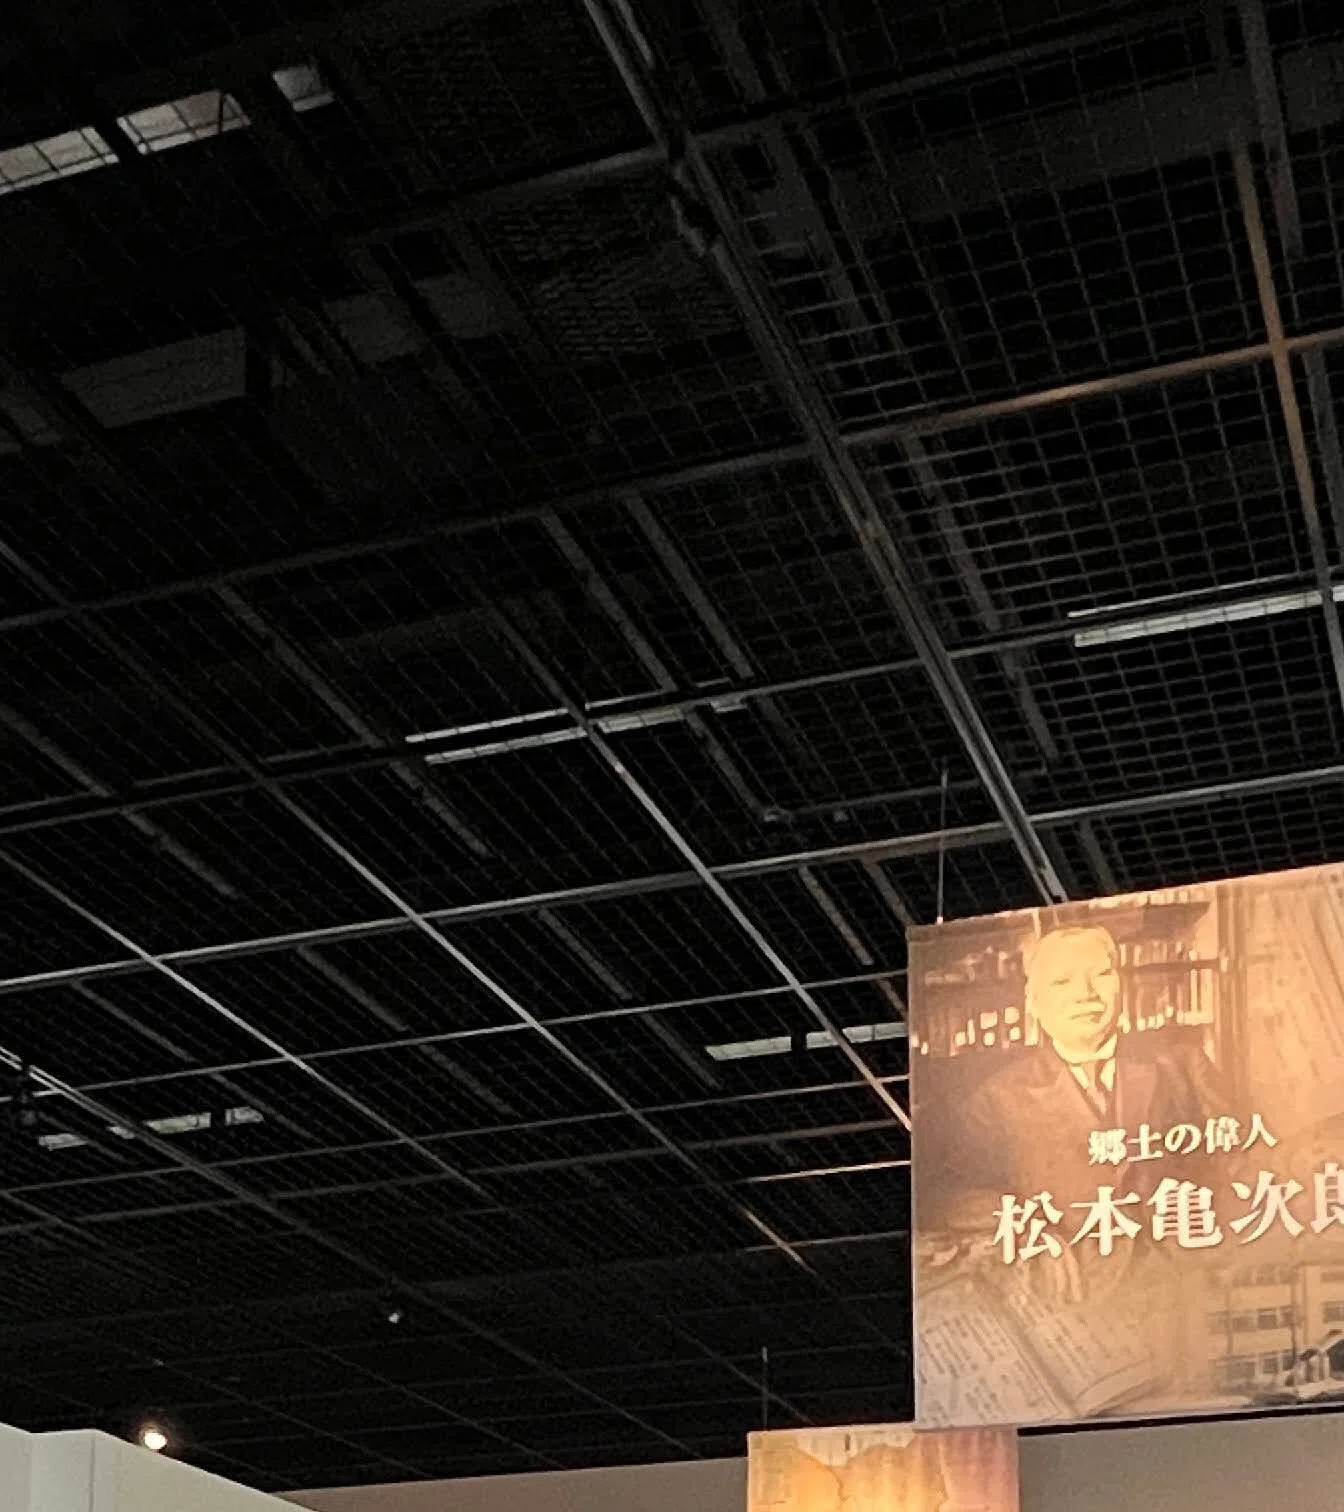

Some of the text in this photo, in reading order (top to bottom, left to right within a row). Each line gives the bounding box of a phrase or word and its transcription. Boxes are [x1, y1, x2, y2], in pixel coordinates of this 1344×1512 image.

[1088, 1112, 1279, 1166] 郷土の偉人
